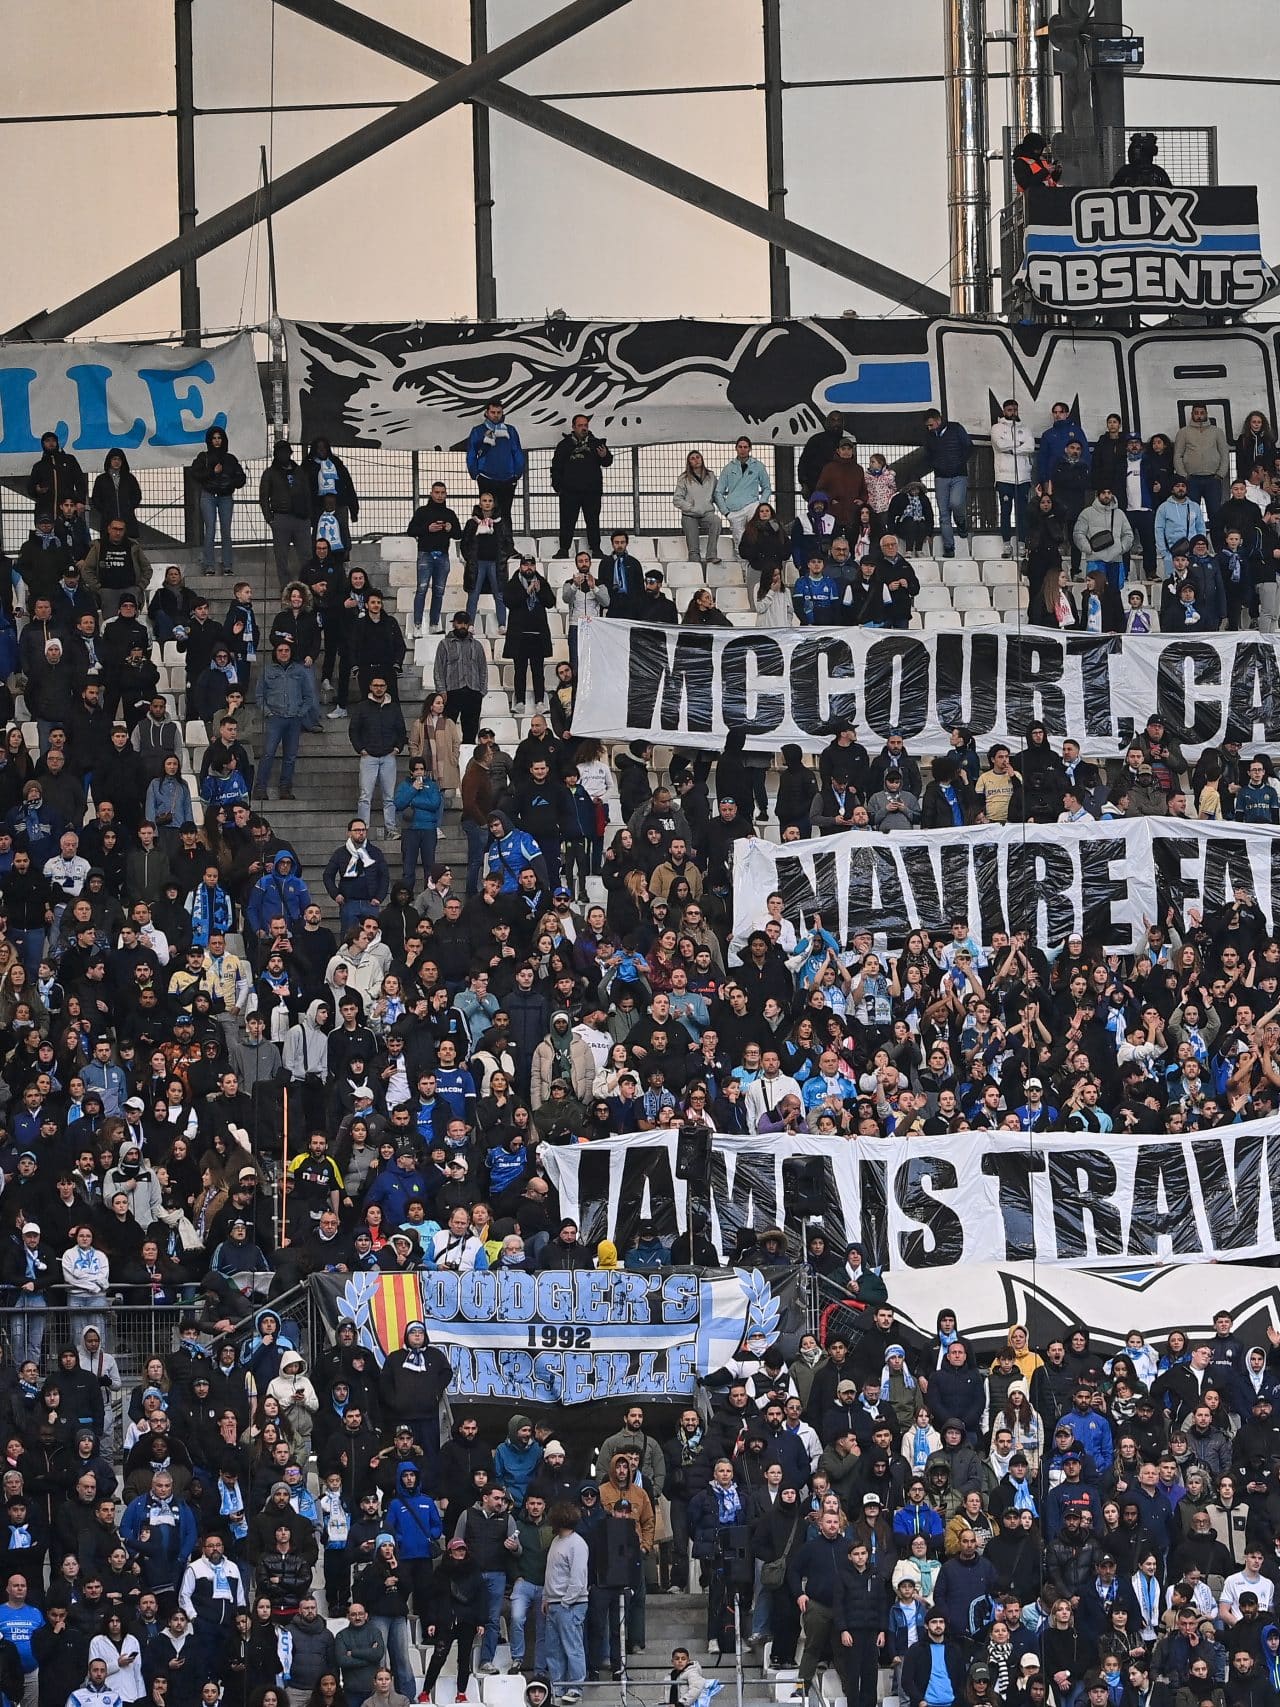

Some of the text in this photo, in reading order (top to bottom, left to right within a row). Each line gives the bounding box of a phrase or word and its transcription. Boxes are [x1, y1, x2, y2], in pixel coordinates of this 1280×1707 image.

[1080, 193, 1192, 240] AUX
[1028, 256, 1265, 302] ABSENTS
[775, 837, 1133, 950] NAVIRE
[421, 1270, 699, 1323] DODGER'S
[527, 1324, 591, 1349] 1992
[444, 1344, 698, 1406] MARSEILLE
